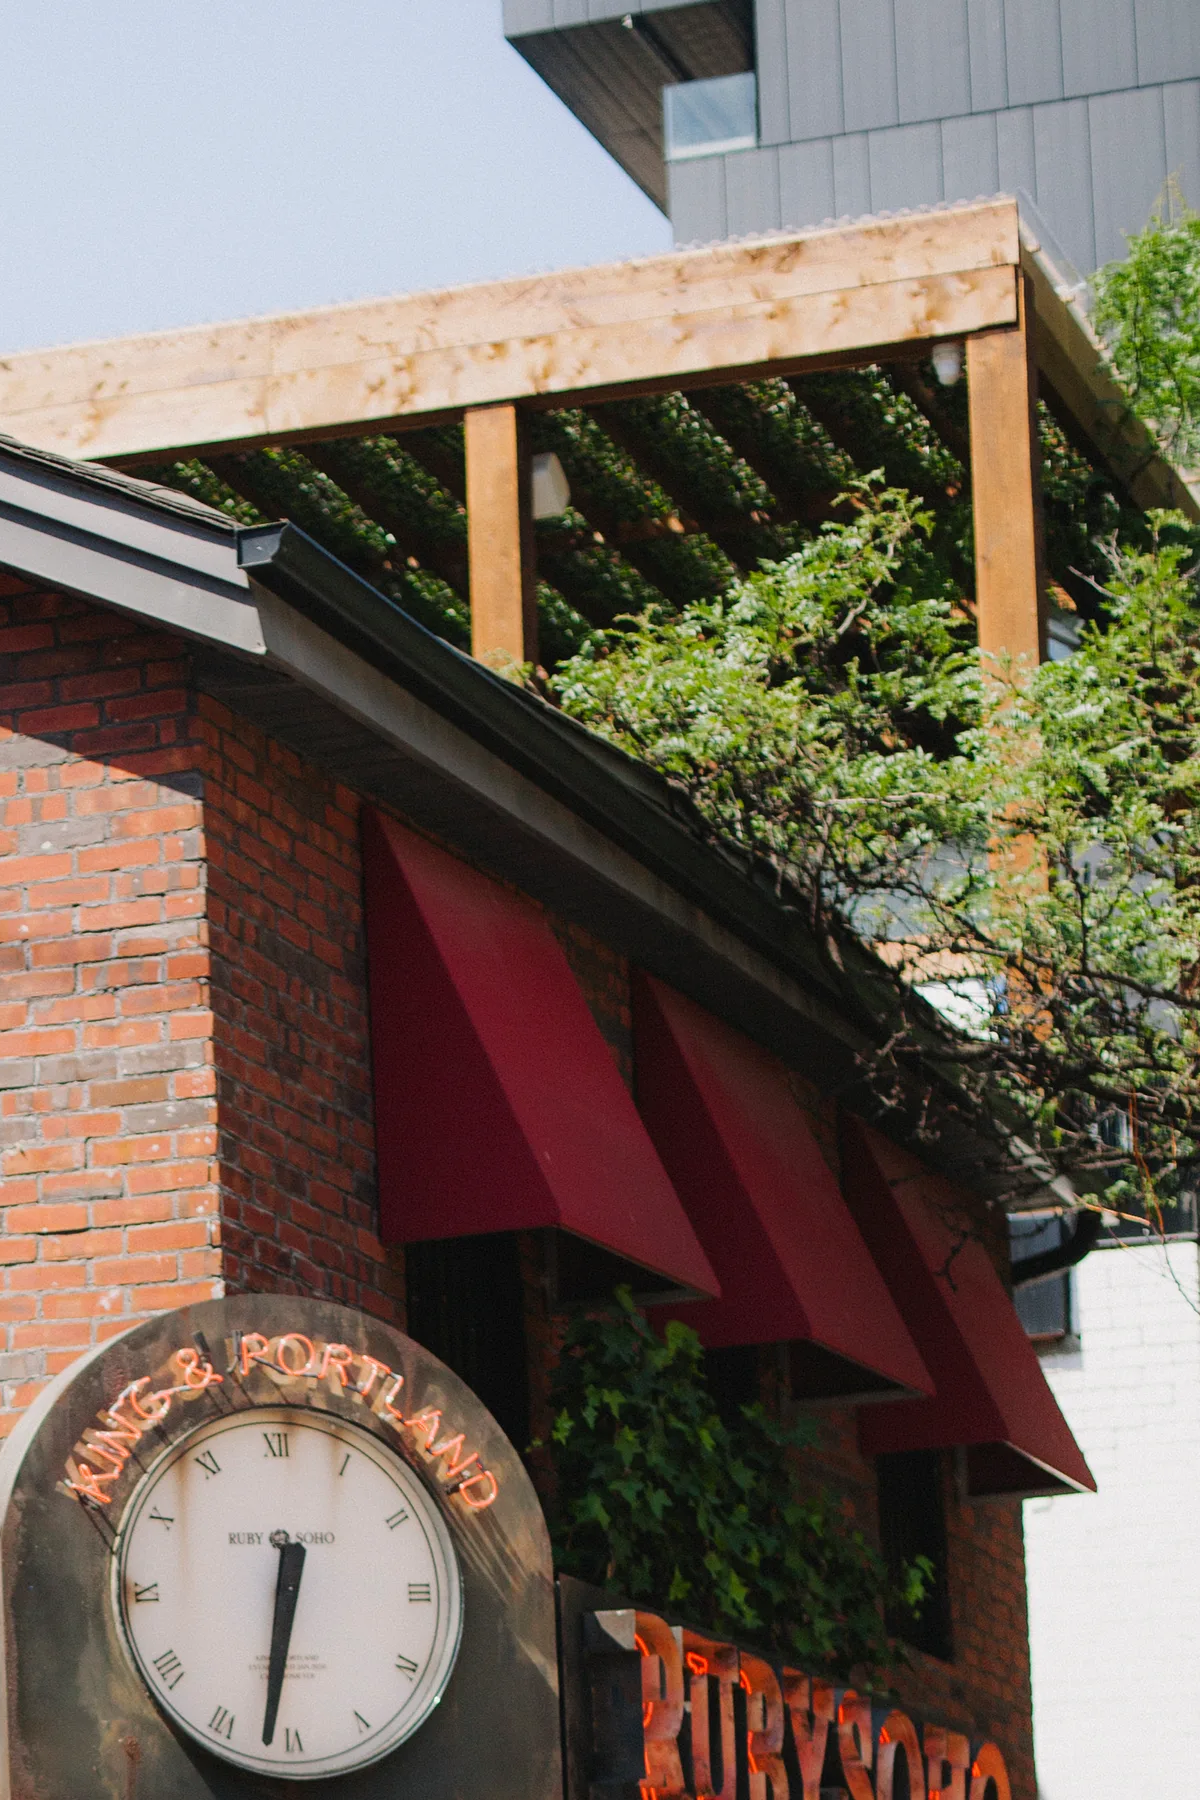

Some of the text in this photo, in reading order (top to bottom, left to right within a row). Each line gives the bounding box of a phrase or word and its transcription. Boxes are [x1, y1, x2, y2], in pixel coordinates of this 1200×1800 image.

[62, 1331, 499, 1508] KING & PORTLAND
[263, 1432, 290, 1457] XII
[195, 1450, 222, 1480] XI
[149, 1506, 175, 1531] X
[386, 1508, 409, 1531] II
[228, 1532, 336, 1545] RUBY SOHO
[134, 1582, 160, 1604] IX
[408, 1583, 431, 1603] III
